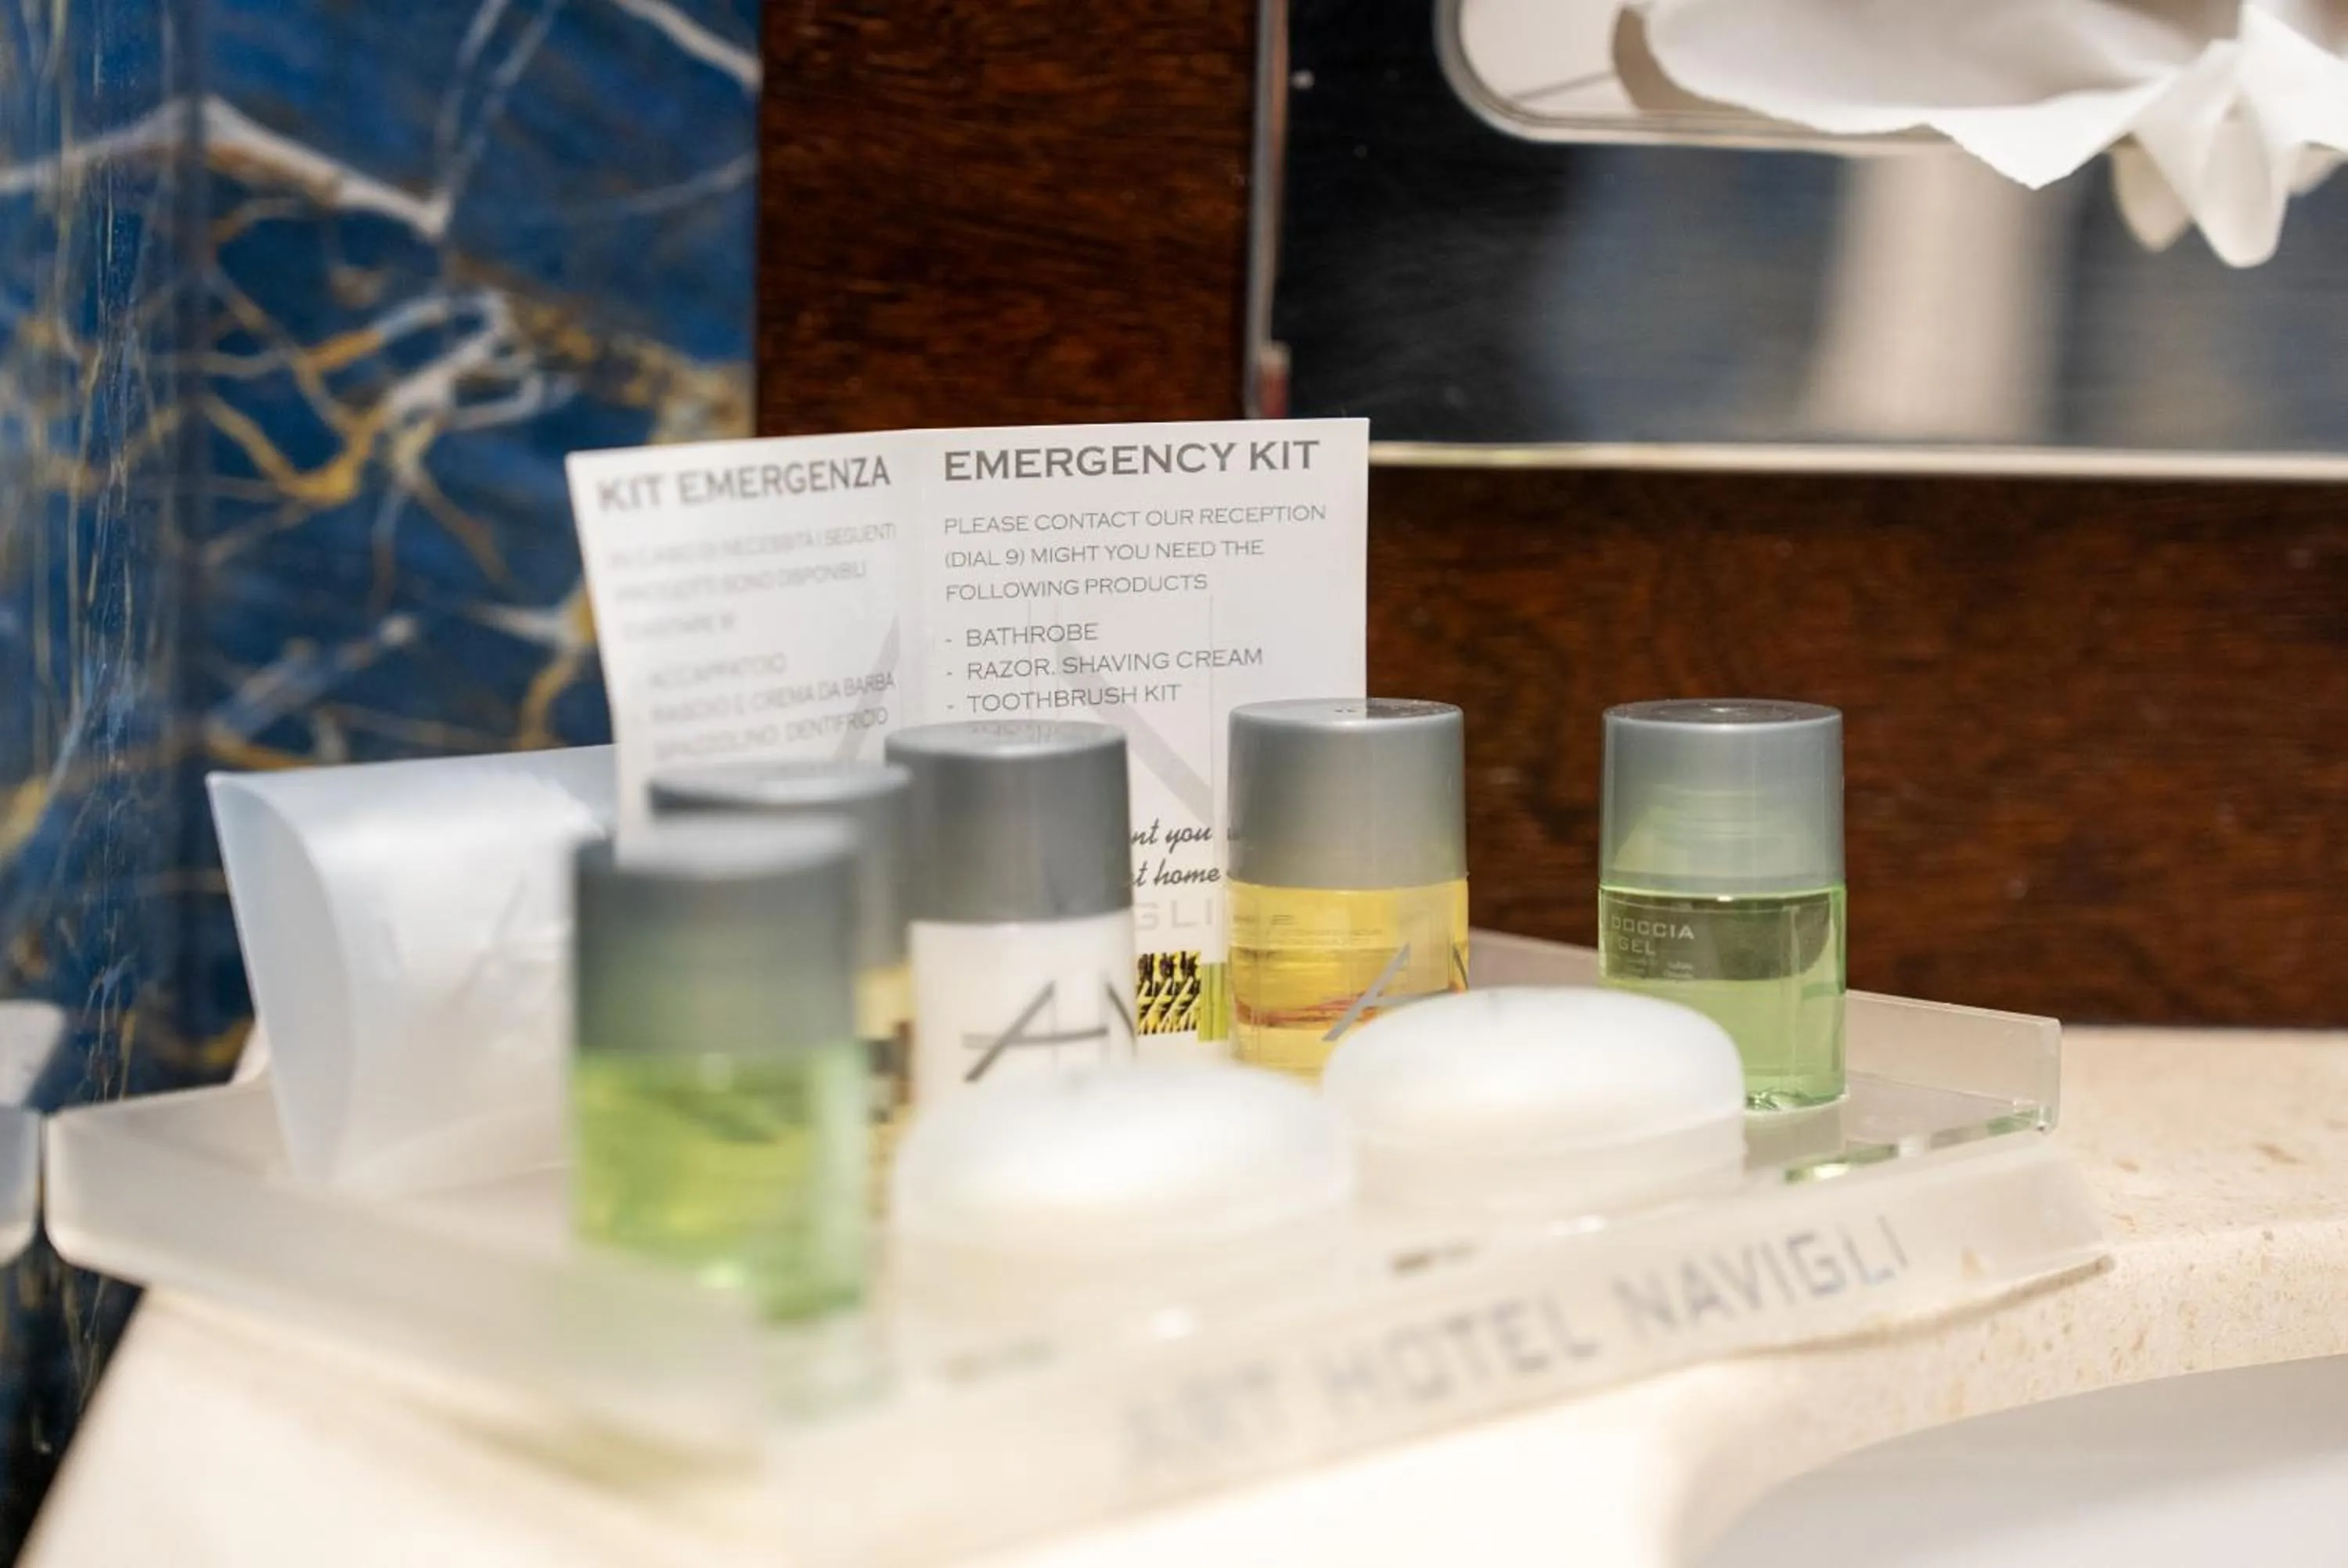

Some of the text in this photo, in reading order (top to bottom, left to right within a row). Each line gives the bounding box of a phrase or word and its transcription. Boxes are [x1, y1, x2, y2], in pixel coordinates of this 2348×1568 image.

[945, 440, 1320, 481] EMERGENCY KIT
[596, 455, 891, 512] KIT EMERGENZA
[945, 504, 1327, 534] PLEASE CONTACT OUR RECEPTION
[945, 539, 1265, 569] (DIAL 9) MIGHT YOU NEED THE
[945, 574, 1208, 602] FOLLOWING PRODUCTS
[966, 623, 1099, 647] BATHROBE
[1062, 652, 1170, 675] SHAVING
[1176, 648, 1264, 670] CREAM
[843, 671, 896, 696] BARBA
[967, 683, 1183, 714] TOOTHBRUSH KIT
[1165, 825, 1213, 854] you
[1154, 858, 1222, 888] home
[1611, 914, 1695, 940] DOCCIA
[1618, 936, 1657, 958] GEL
[1312, 1288, 1601, 1421] HOTEL
[1609, 1213, 1913, 1341] NAVIGLI
